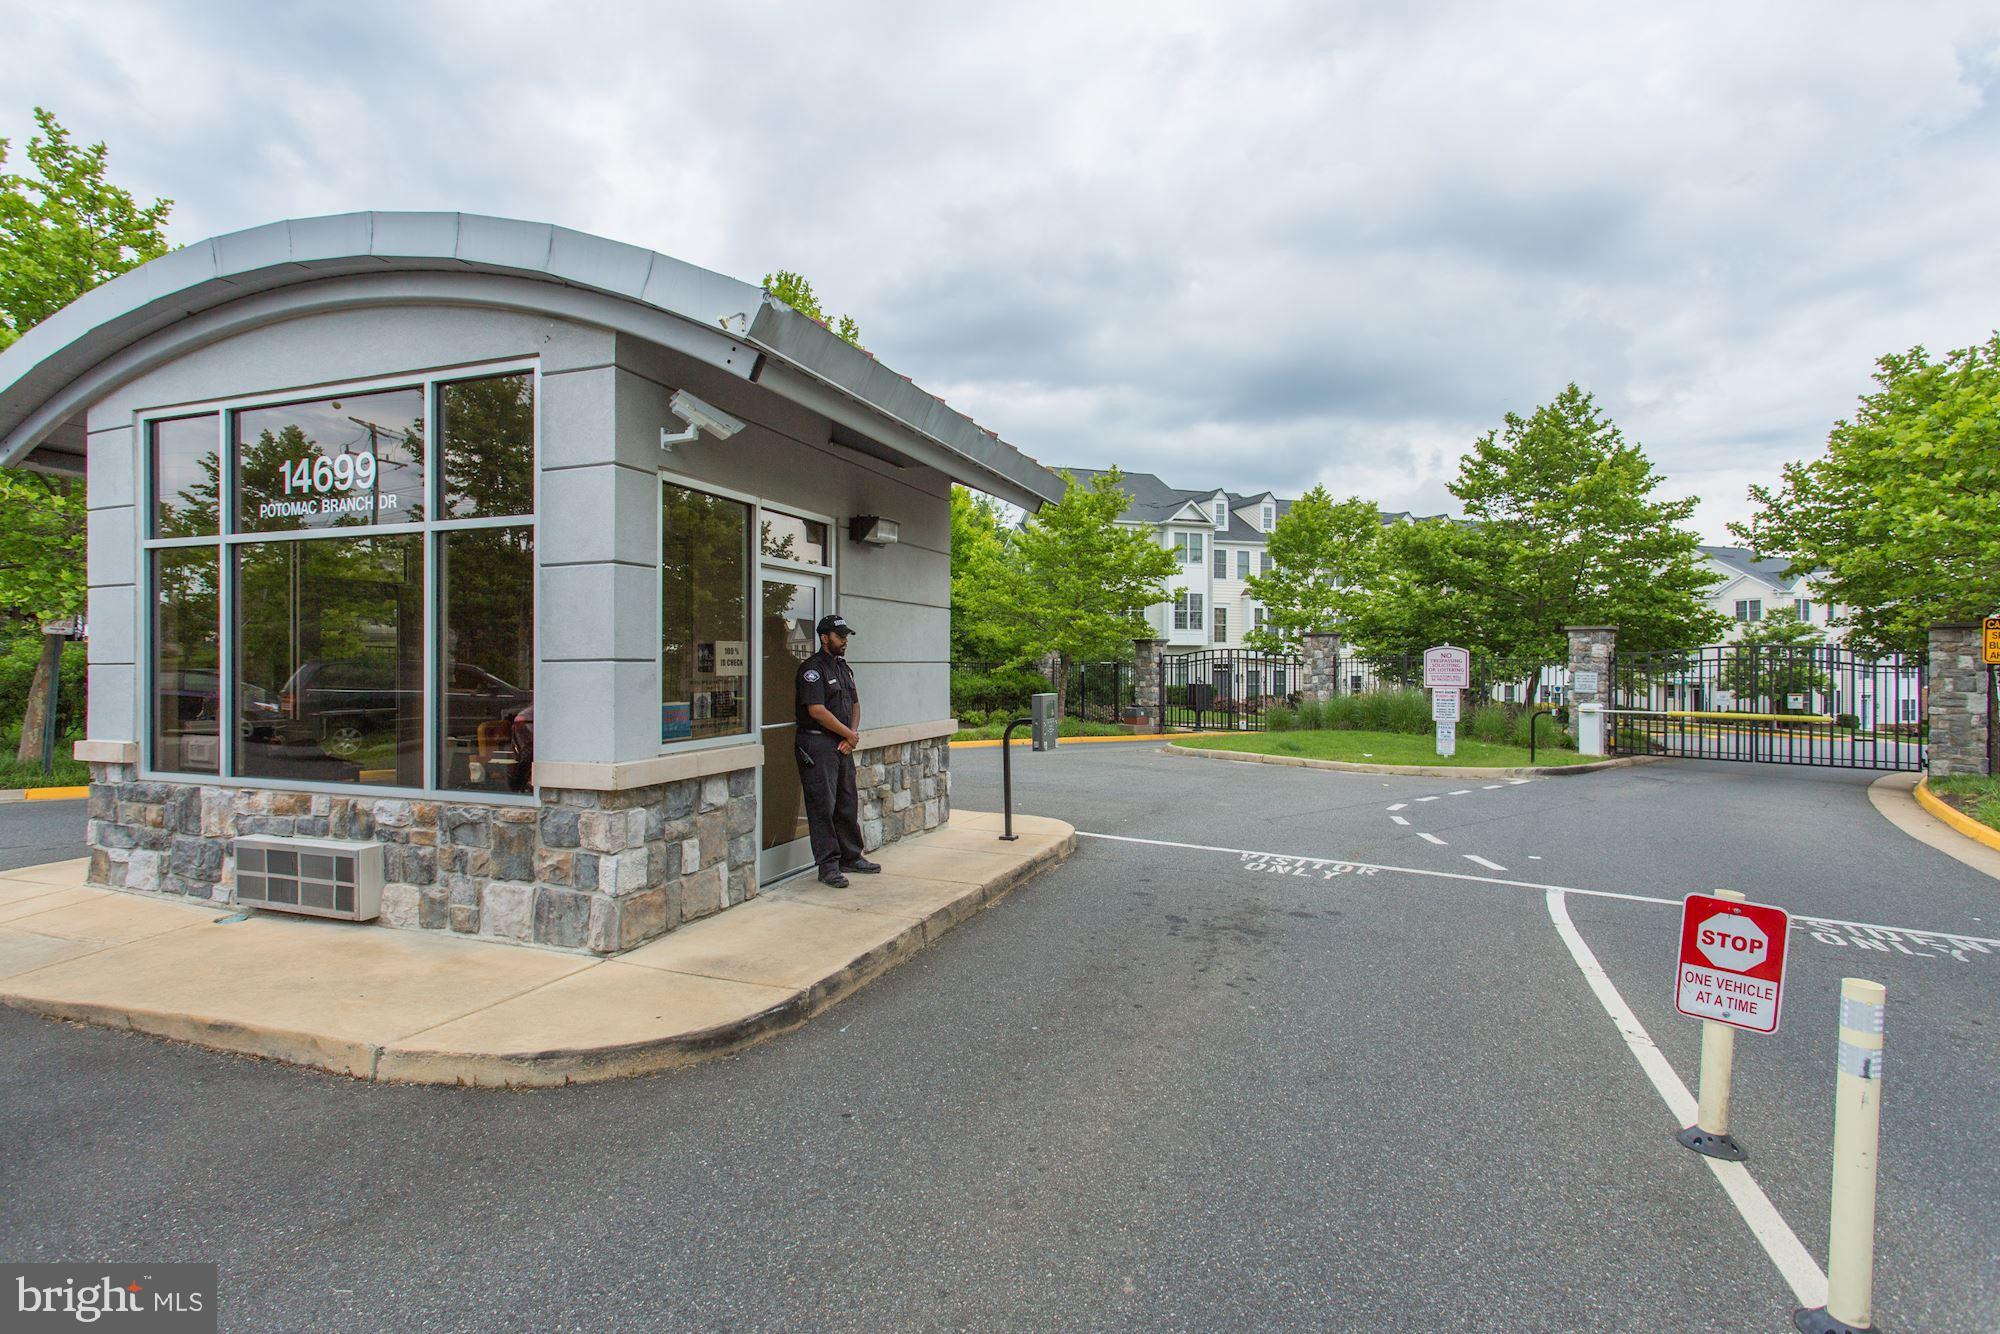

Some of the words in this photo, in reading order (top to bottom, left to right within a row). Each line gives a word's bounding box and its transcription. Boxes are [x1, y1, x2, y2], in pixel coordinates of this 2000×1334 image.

[279, 451, 377, 495] 14699
[259, 499, 317, 519] POTOMAC
[321, 495, 374, 514] BRANCH
[379, 494, 397, 509] DR
[727, 658, 743, 667] CHECK
[1244, 863, 1341, 880] ONLY
[1701, 930, 1764, 954] STOP
[1810, 931, 1970, 963] ONLY
[1685, 971, 1713, 987] ONE
[1716, 977, 1774, 1000] VEHICLE
[1695, 990, 1713, 1004] AT
[1713, 995, 1723, 1008] A
[1726, 996, 1758, 1015] TIME
